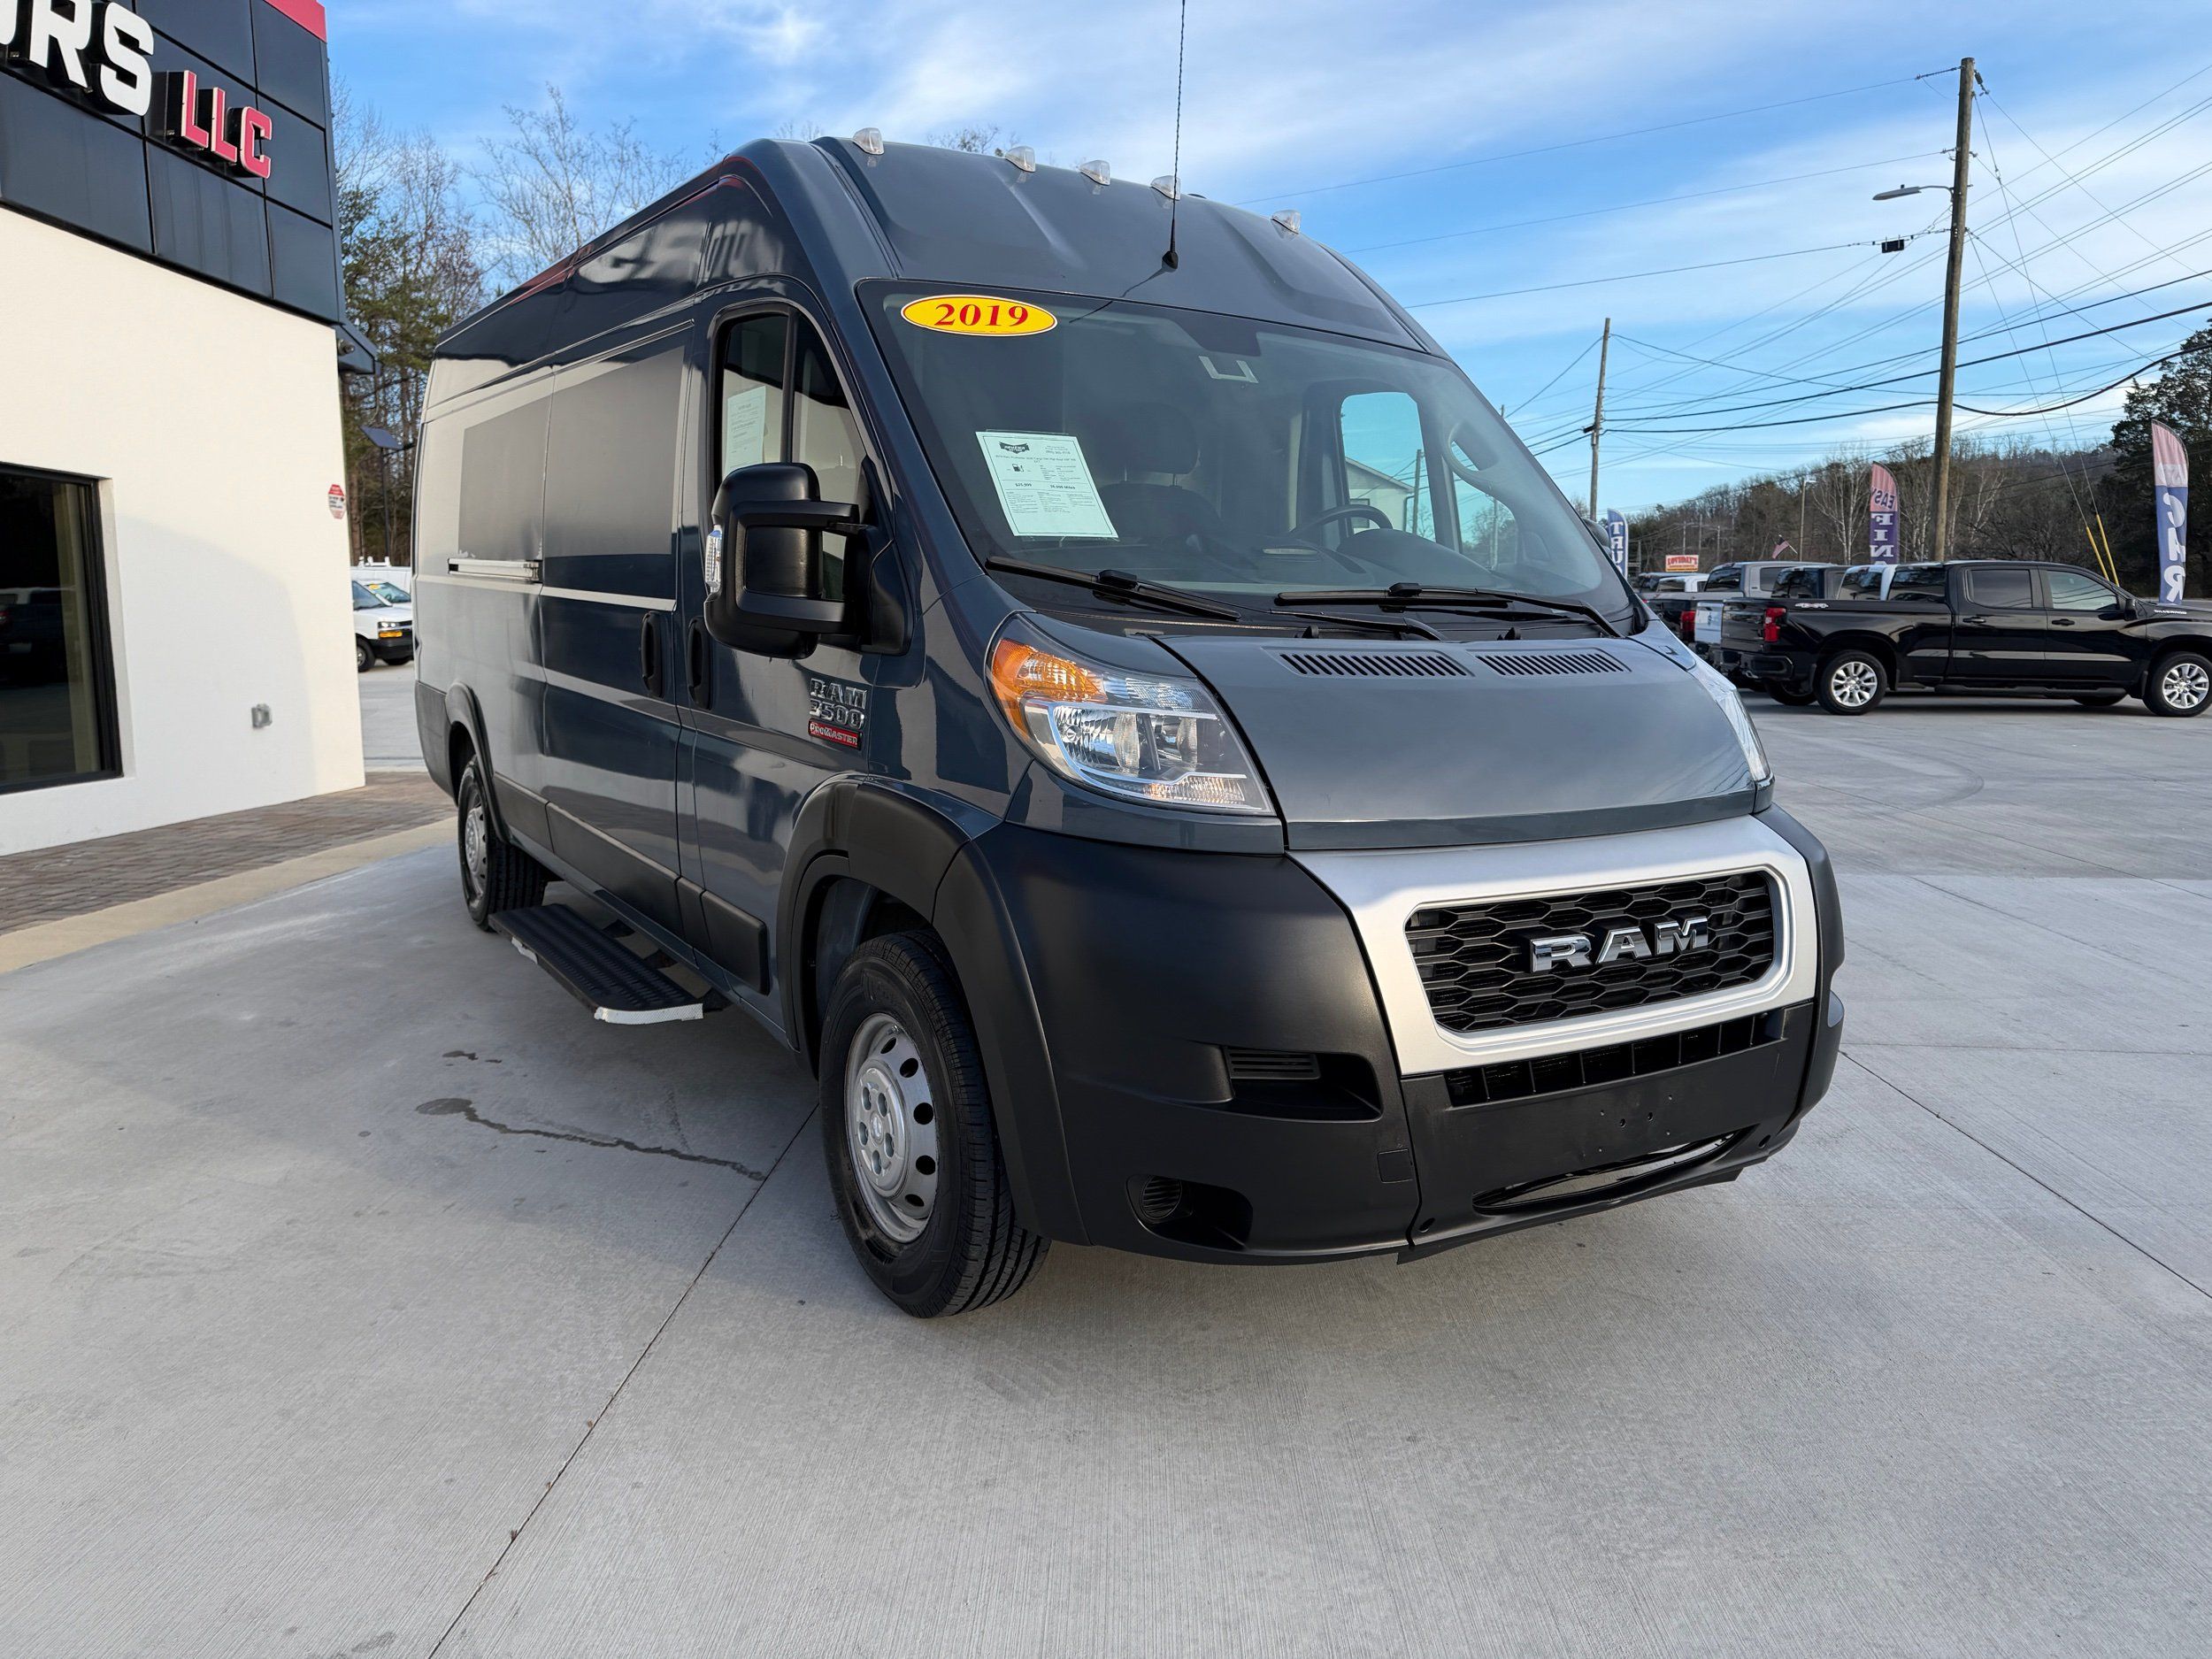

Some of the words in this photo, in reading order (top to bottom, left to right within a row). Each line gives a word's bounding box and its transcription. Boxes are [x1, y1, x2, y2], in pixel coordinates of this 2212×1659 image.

[0, 0, 154, 117] RS
[181, 70, 272, 179] LLC
[933, 303, 1029, 328] 2019
[1610, 521, 1624, 574] TRU
[810, 678, 867, 710] RAM
[1530, 916, 1709, 973] RAM
